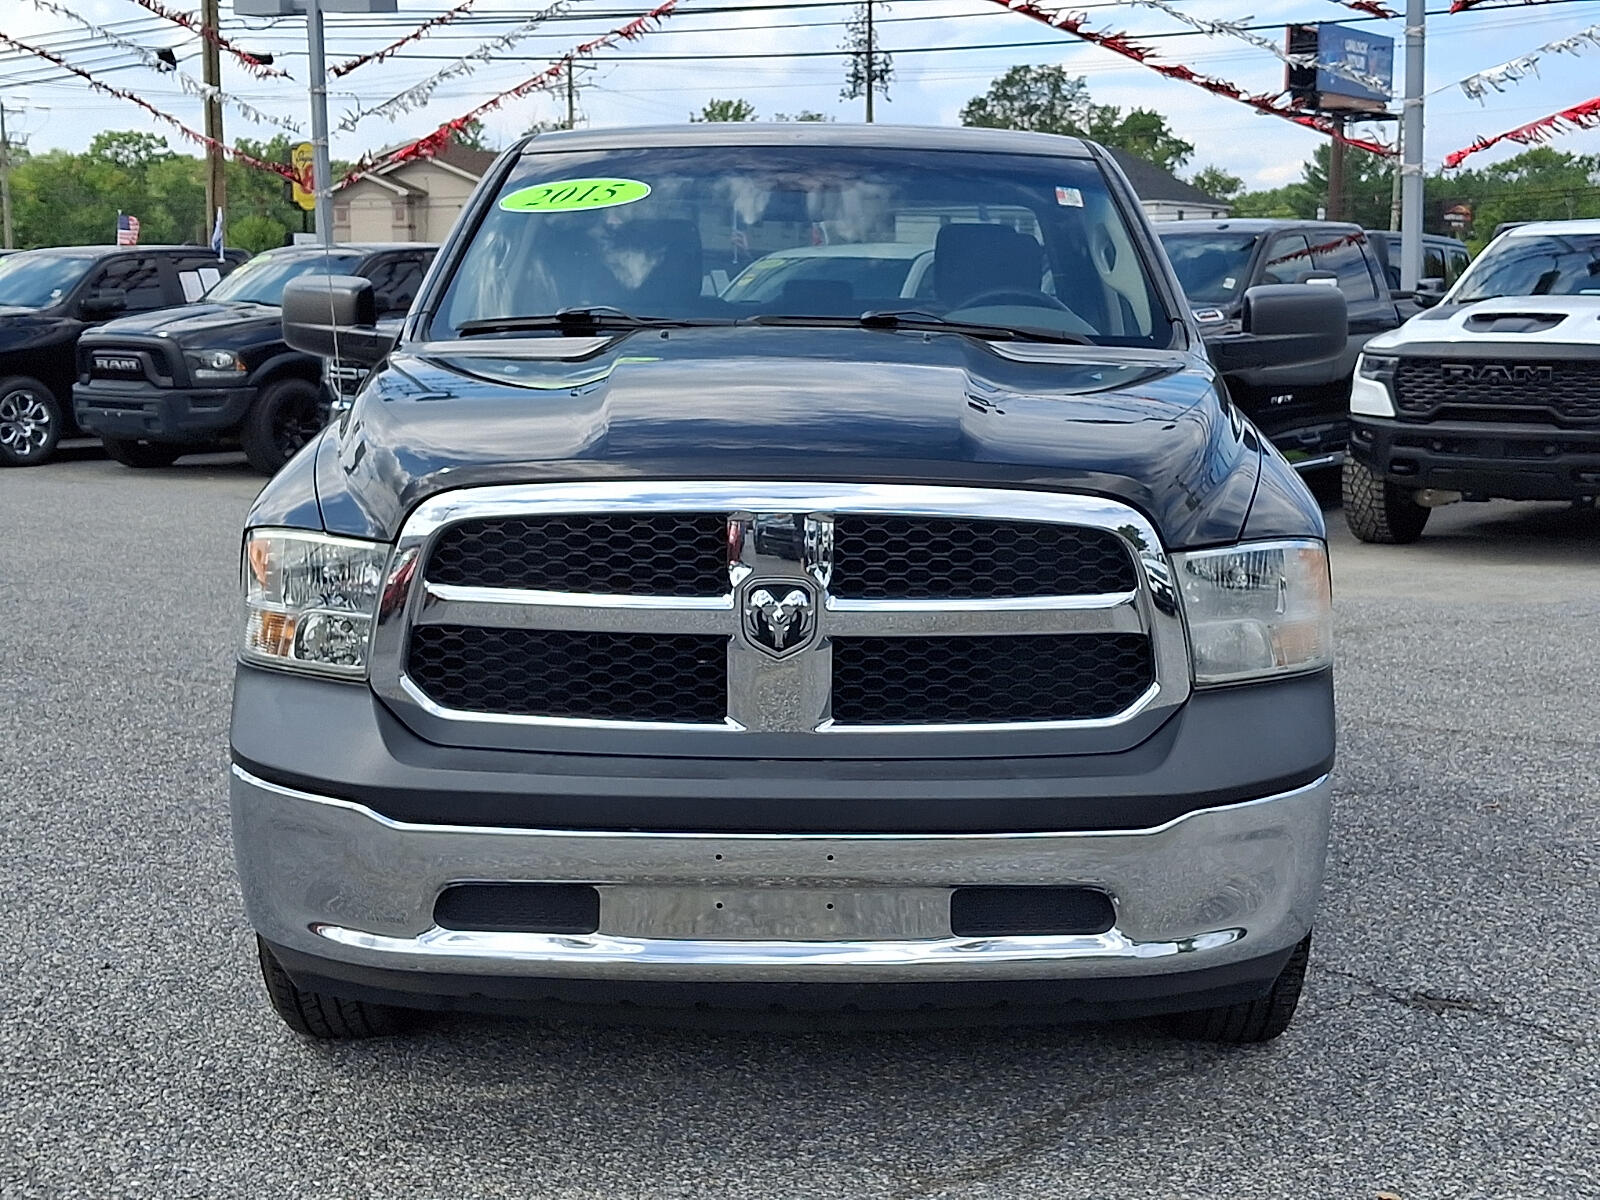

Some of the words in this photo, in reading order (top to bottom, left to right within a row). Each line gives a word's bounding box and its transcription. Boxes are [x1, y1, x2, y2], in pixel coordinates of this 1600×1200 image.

[523, 183, 626, 206] 2015
[95, 359, 138, 370] RAM
[1441, 364, 1552, 382] RAM
